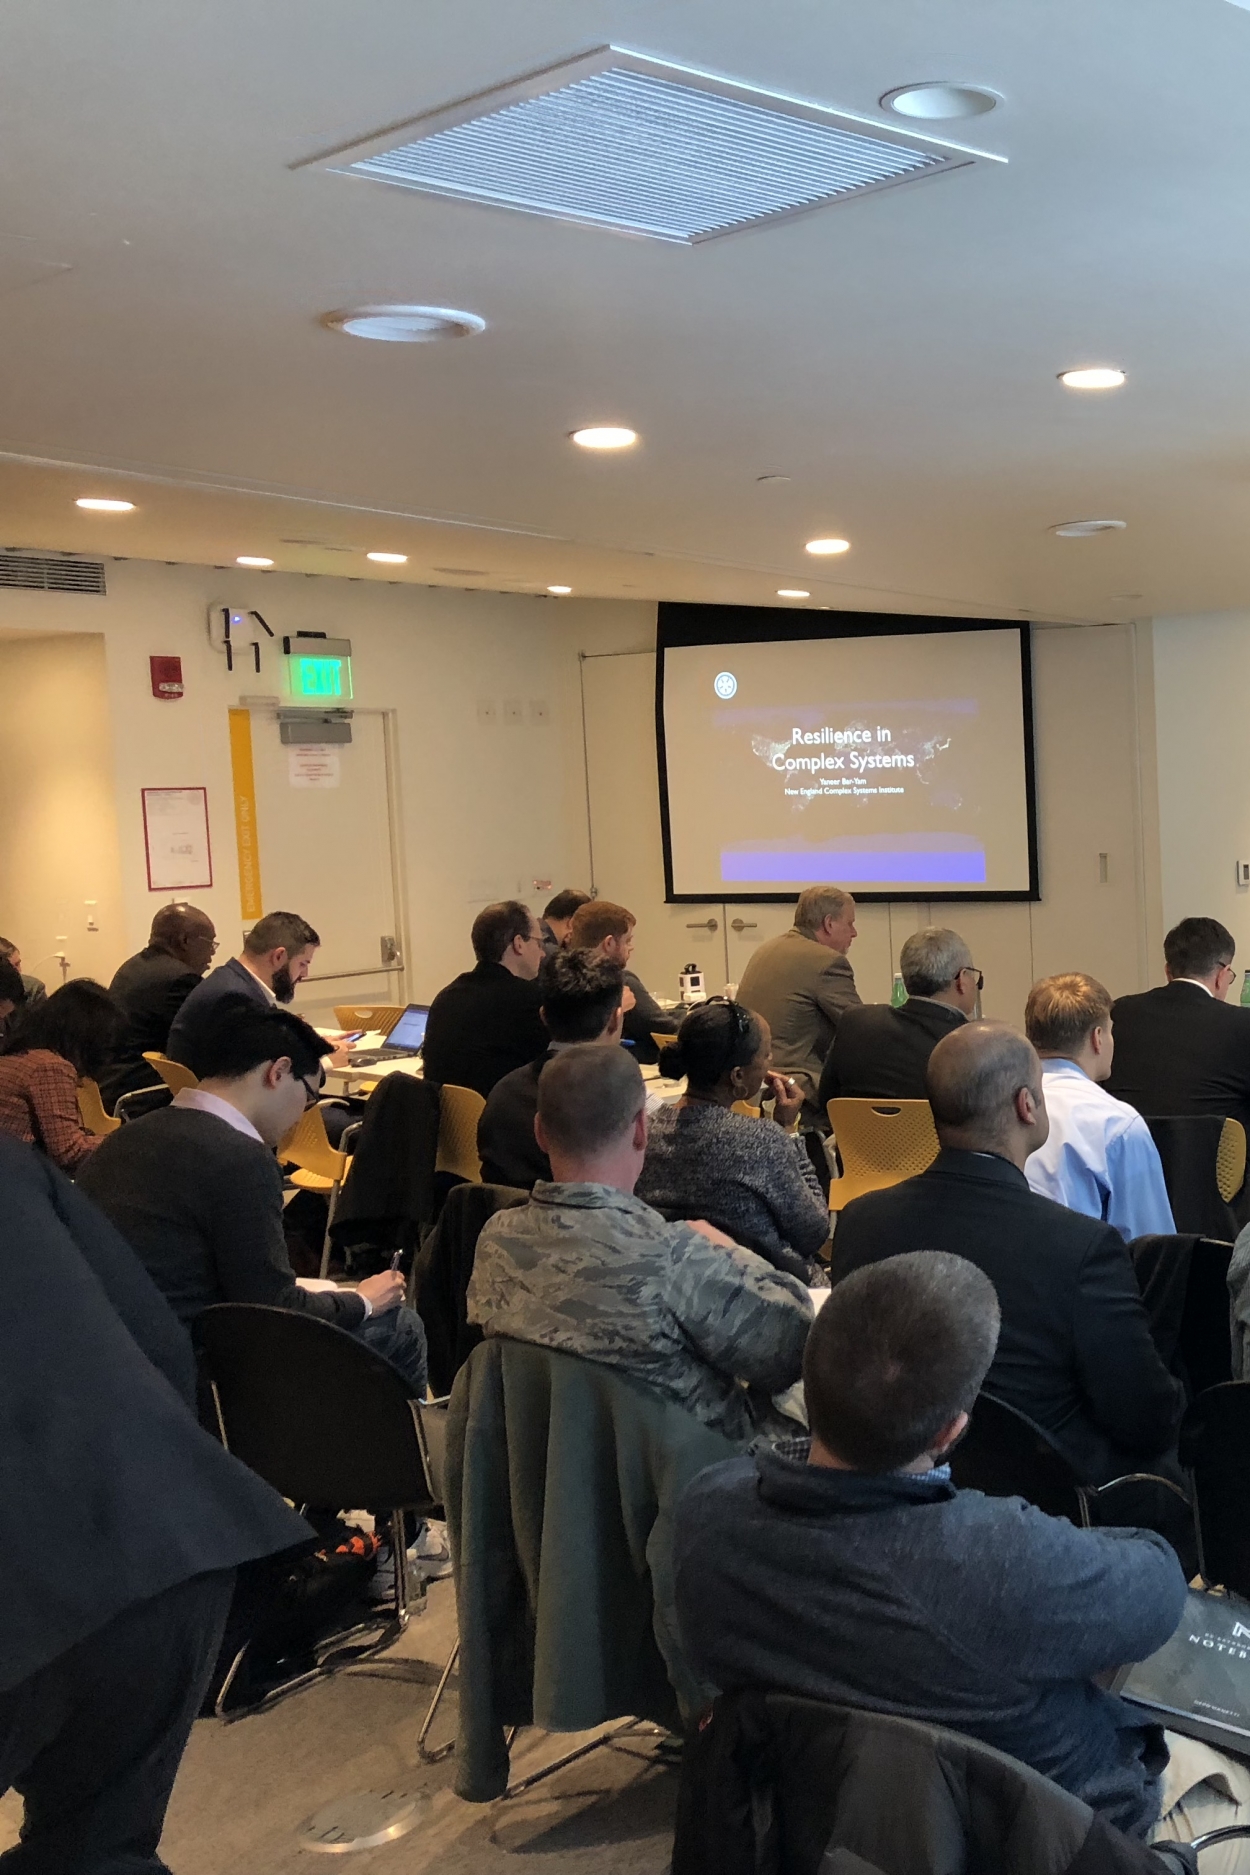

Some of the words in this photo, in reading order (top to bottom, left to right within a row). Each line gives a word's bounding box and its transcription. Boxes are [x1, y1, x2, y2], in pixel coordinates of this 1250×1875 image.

[300, 658, 341, 695] EXIT
[792, 728, 871, 745] Resilience
[877, 726, 891, 742] in
[772, 753, 844, 774] Complex
[850, 751, 914, 772] Systems
[800, 787, 822, 796] England
[824, 787, 852, 795] Complex
[853, 786, 877, 795] Systems
[879, 786, 904, 794] Institute
[842, 777, 866, 785] Bar-Yam
[240, 795, 250, 822] ONLY
[241, 823, 252, 846] EXIT
[241, 850, 256, 912] EMERGENCY
